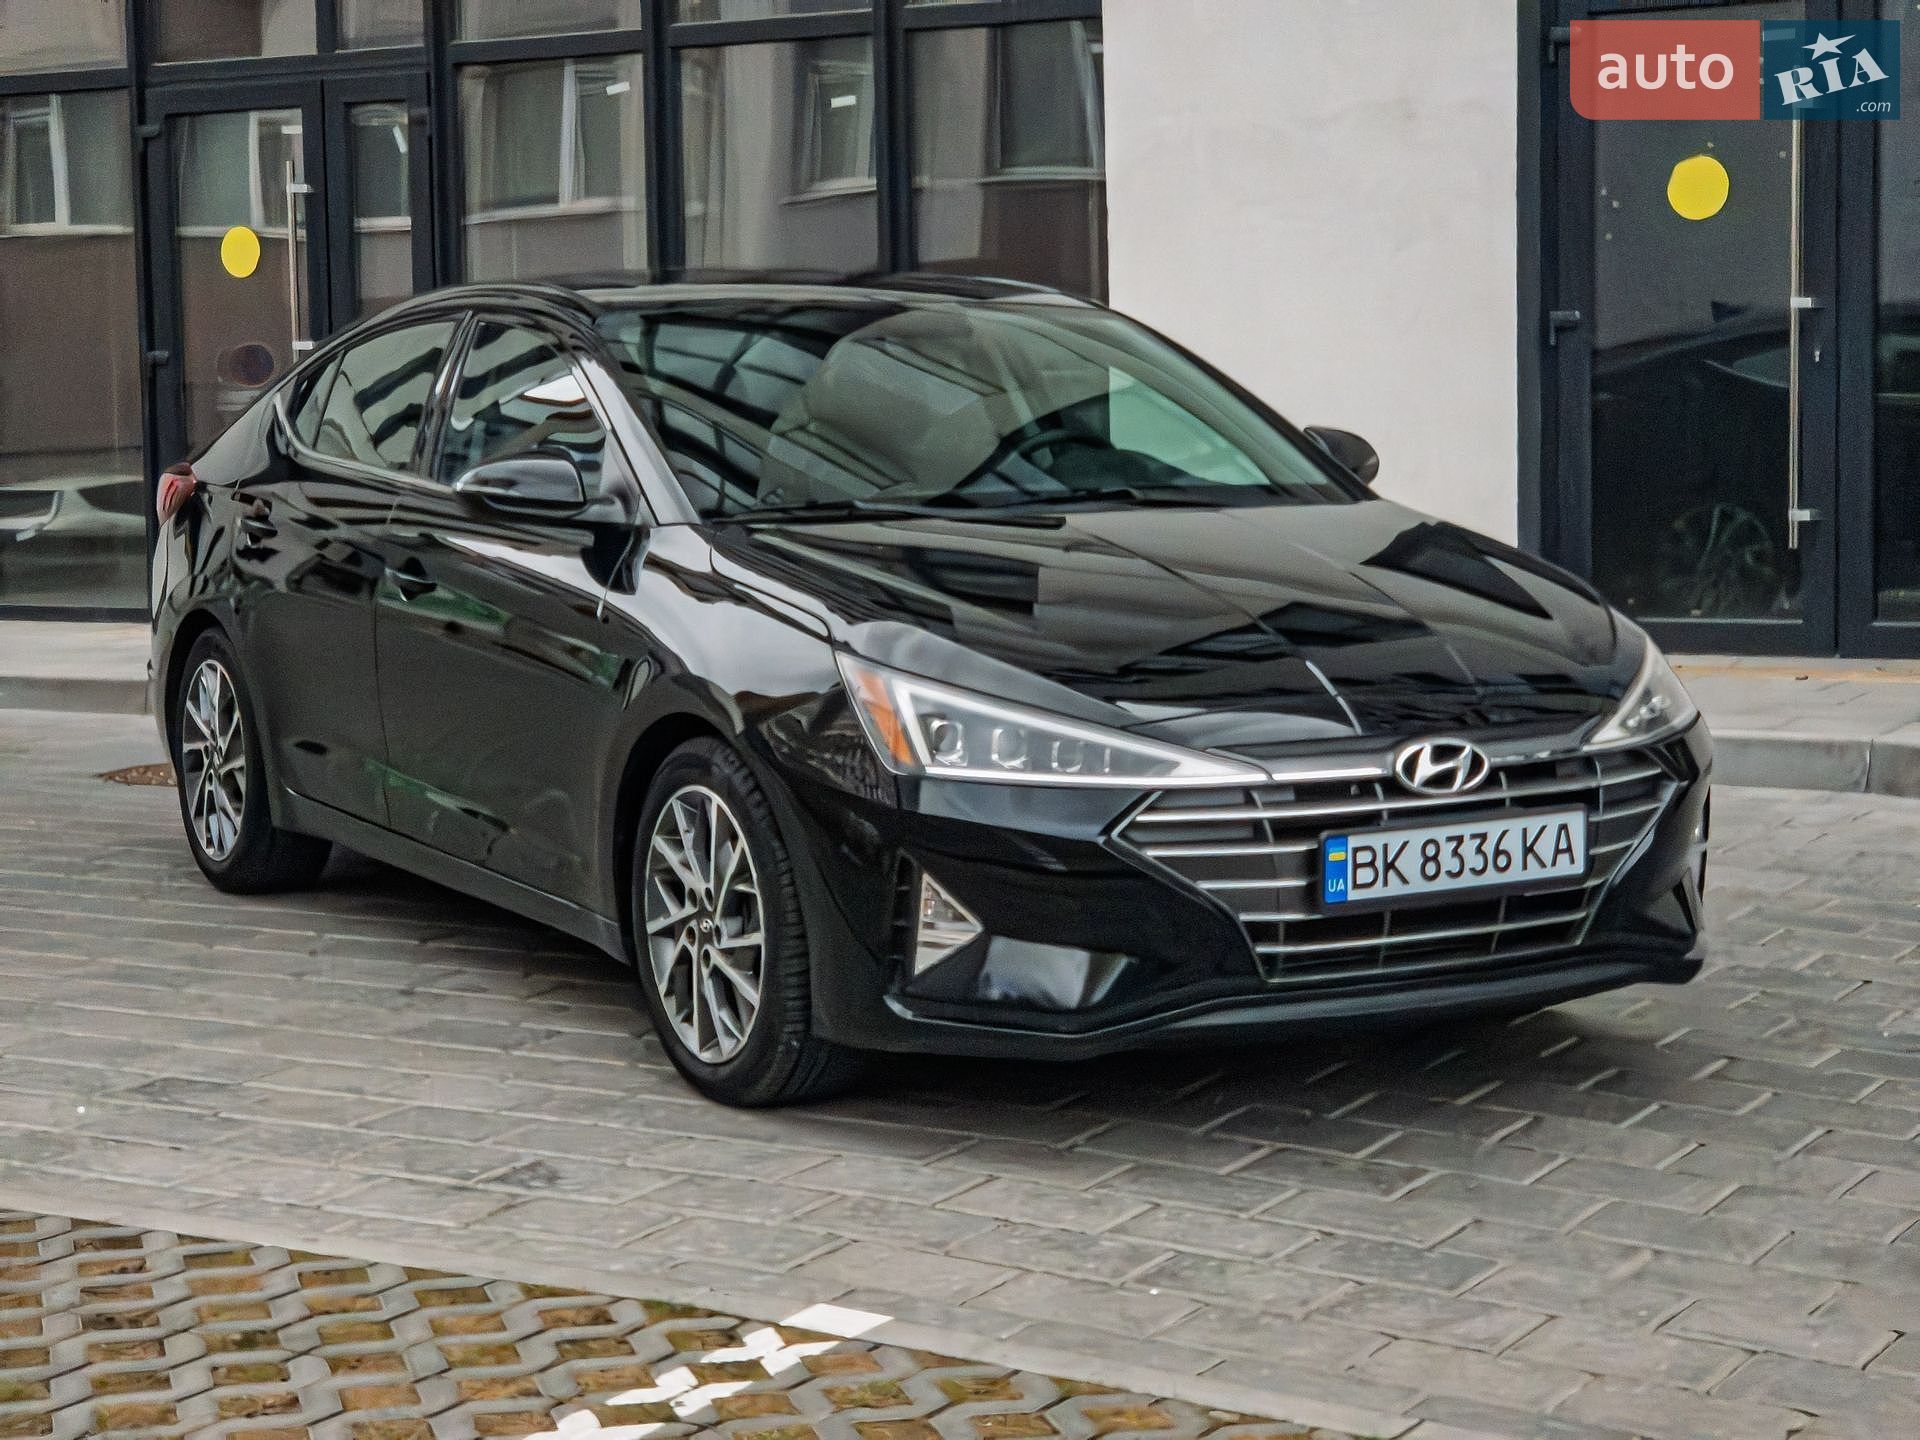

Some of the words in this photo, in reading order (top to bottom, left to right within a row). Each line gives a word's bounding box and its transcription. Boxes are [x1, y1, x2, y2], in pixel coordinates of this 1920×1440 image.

[1351, 840, 1410, 890] BK
[1420, 829, 1512, 882] 8336
[1521, 823, 1576, 871] KA
[1328, 878, 1345, 892] UA
